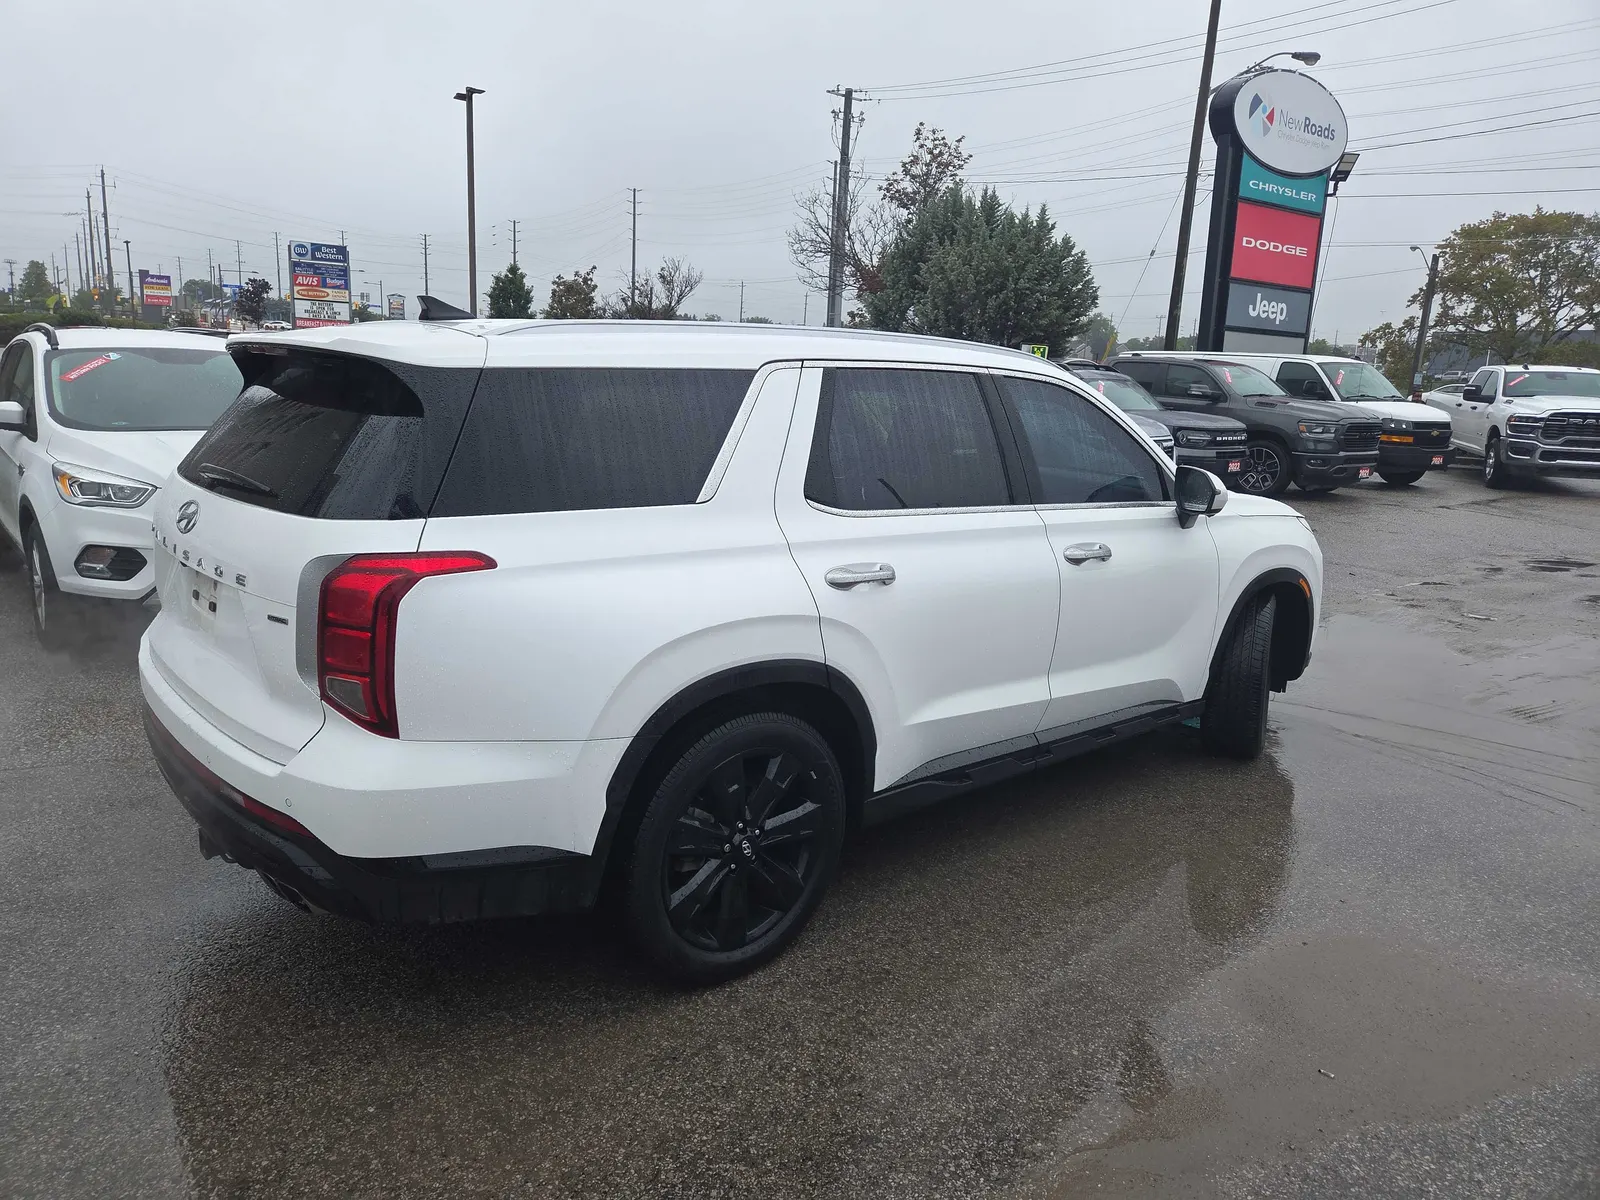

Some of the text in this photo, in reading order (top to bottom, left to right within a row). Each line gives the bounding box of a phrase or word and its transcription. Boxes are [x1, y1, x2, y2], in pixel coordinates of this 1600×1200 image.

[1249, 180, 1316, 202] CHRYSLER
[295, 245, 307, 254] BW
[1242, 236, 1308, 256] DODGE
[296, 276, 318, 285] AVIS
[1248, 293, 1287, 324] Jeep
